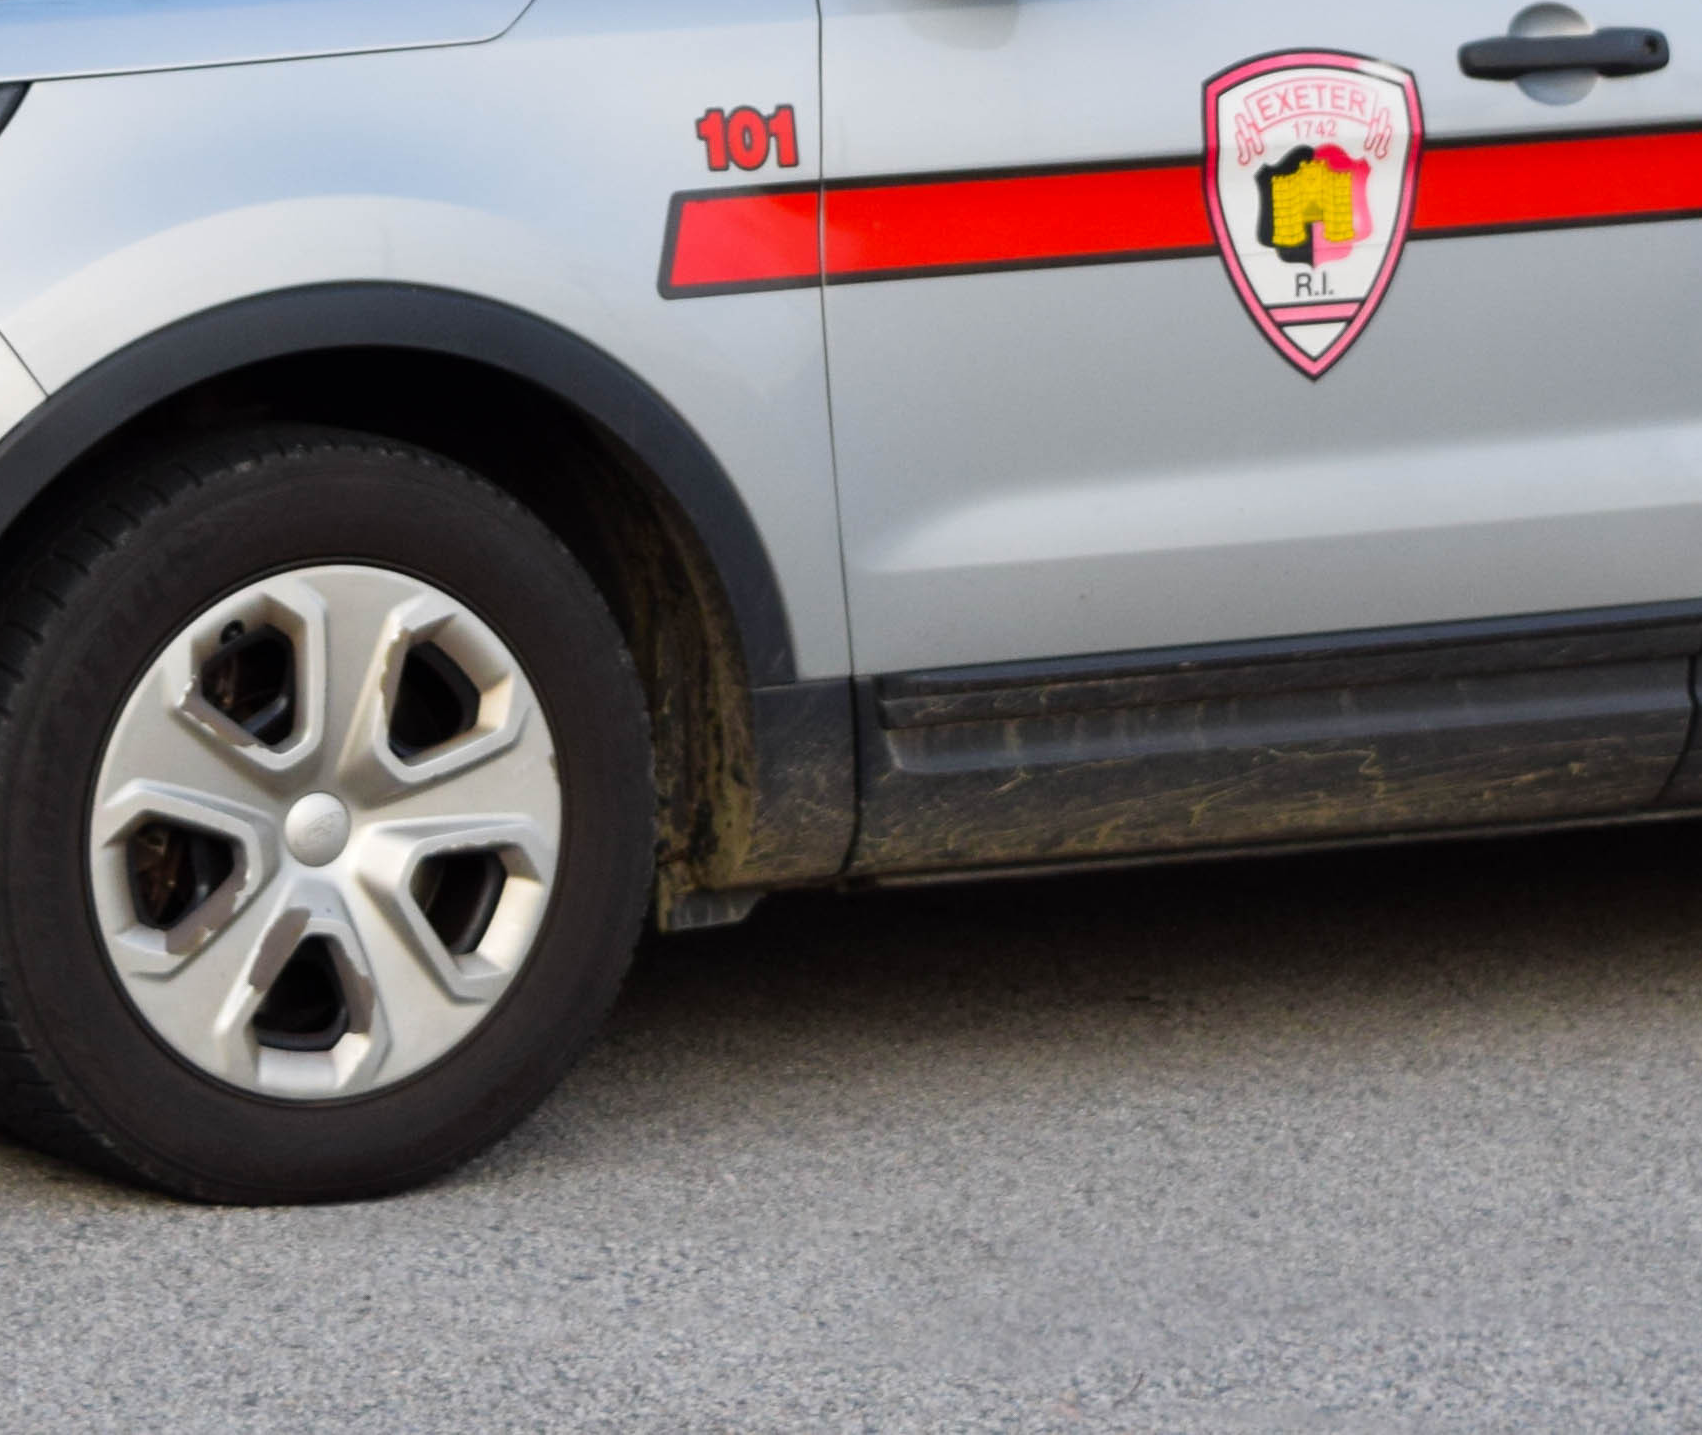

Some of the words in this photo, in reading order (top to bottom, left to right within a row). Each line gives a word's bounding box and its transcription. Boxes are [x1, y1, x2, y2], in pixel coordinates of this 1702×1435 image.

[1256, 83, 1366, 121] EXETER
[695, 103, 800, 172] 101
[1294, 118, 1337, 139] 1742
[1294, 271, 1334, 298] R.I.
